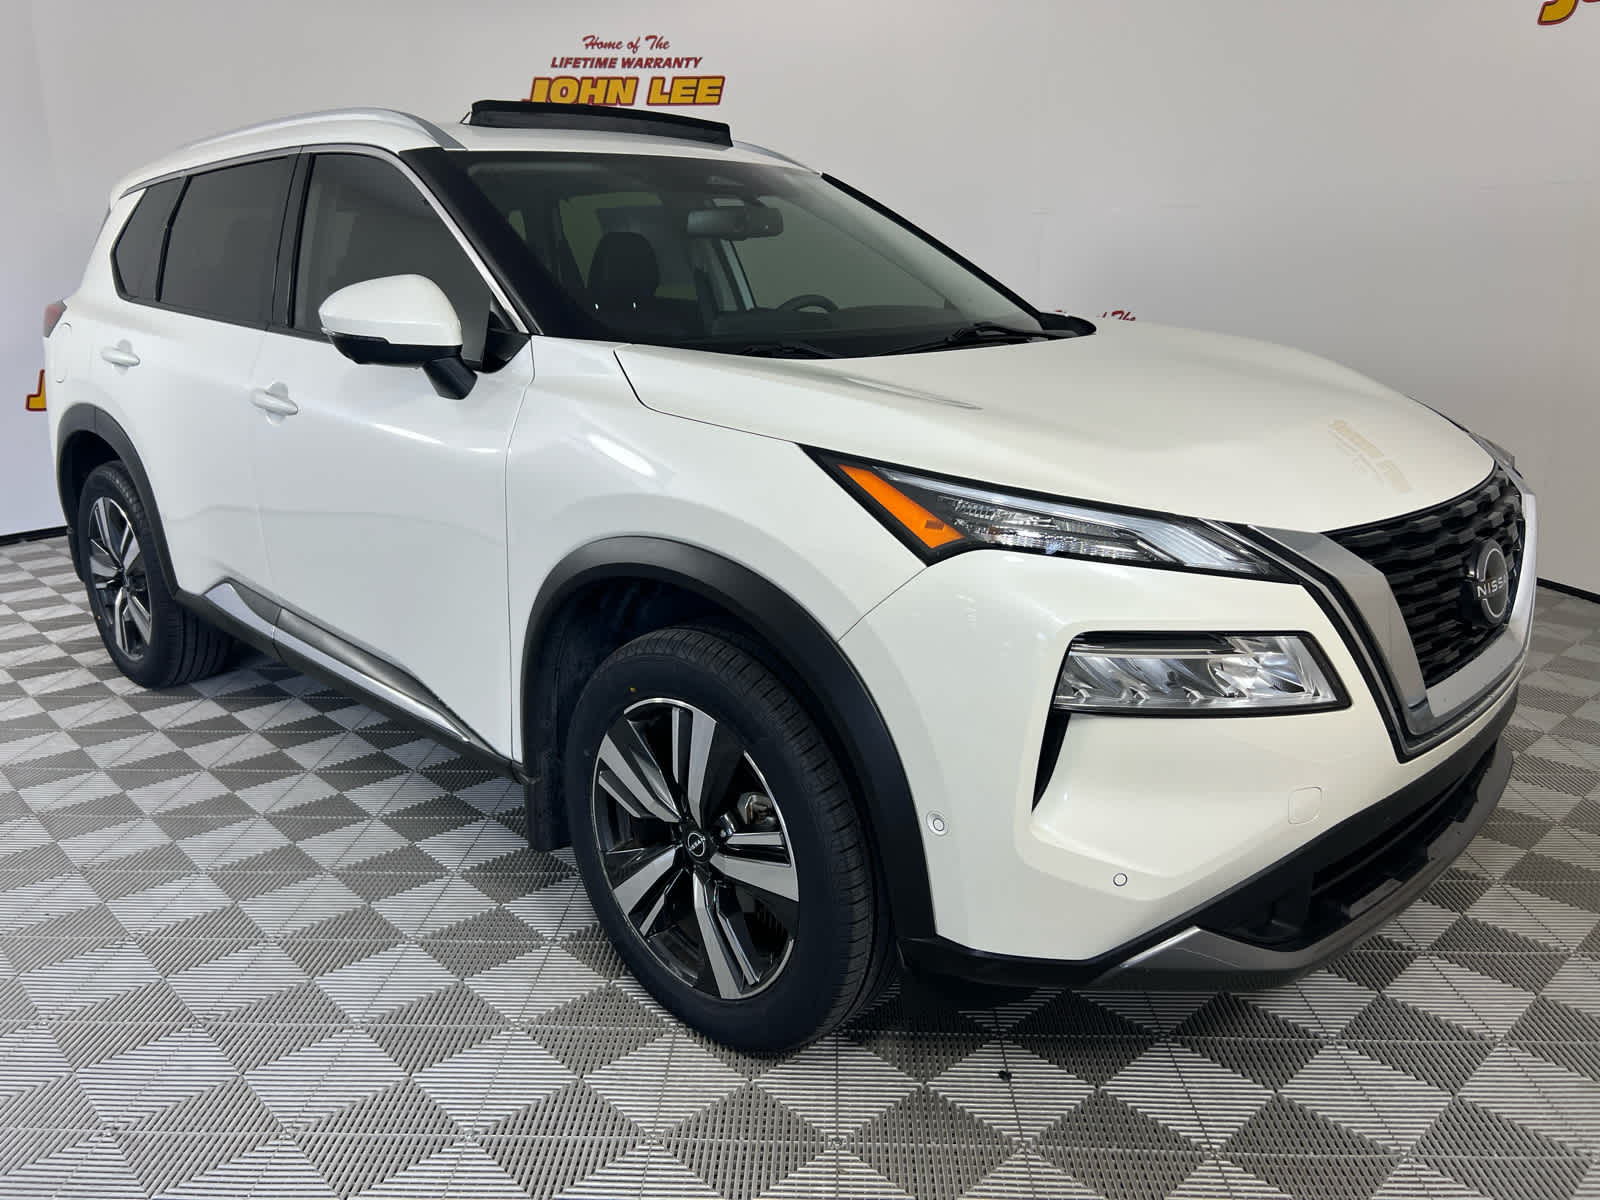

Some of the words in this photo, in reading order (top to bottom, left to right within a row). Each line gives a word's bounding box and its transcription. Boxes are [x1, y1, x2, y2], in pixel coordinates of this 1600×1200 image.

[582, 34, 623, 50] Home
[626, 36, 641, 54] of
[644, 34, 670, 50] The
[550, 56, 618, 69] LIFETIME
[621, 56, 702, 69] WARRANTY
[521, 75, 640, 106] JOHN
[646, 75, 726, 106] LEE
